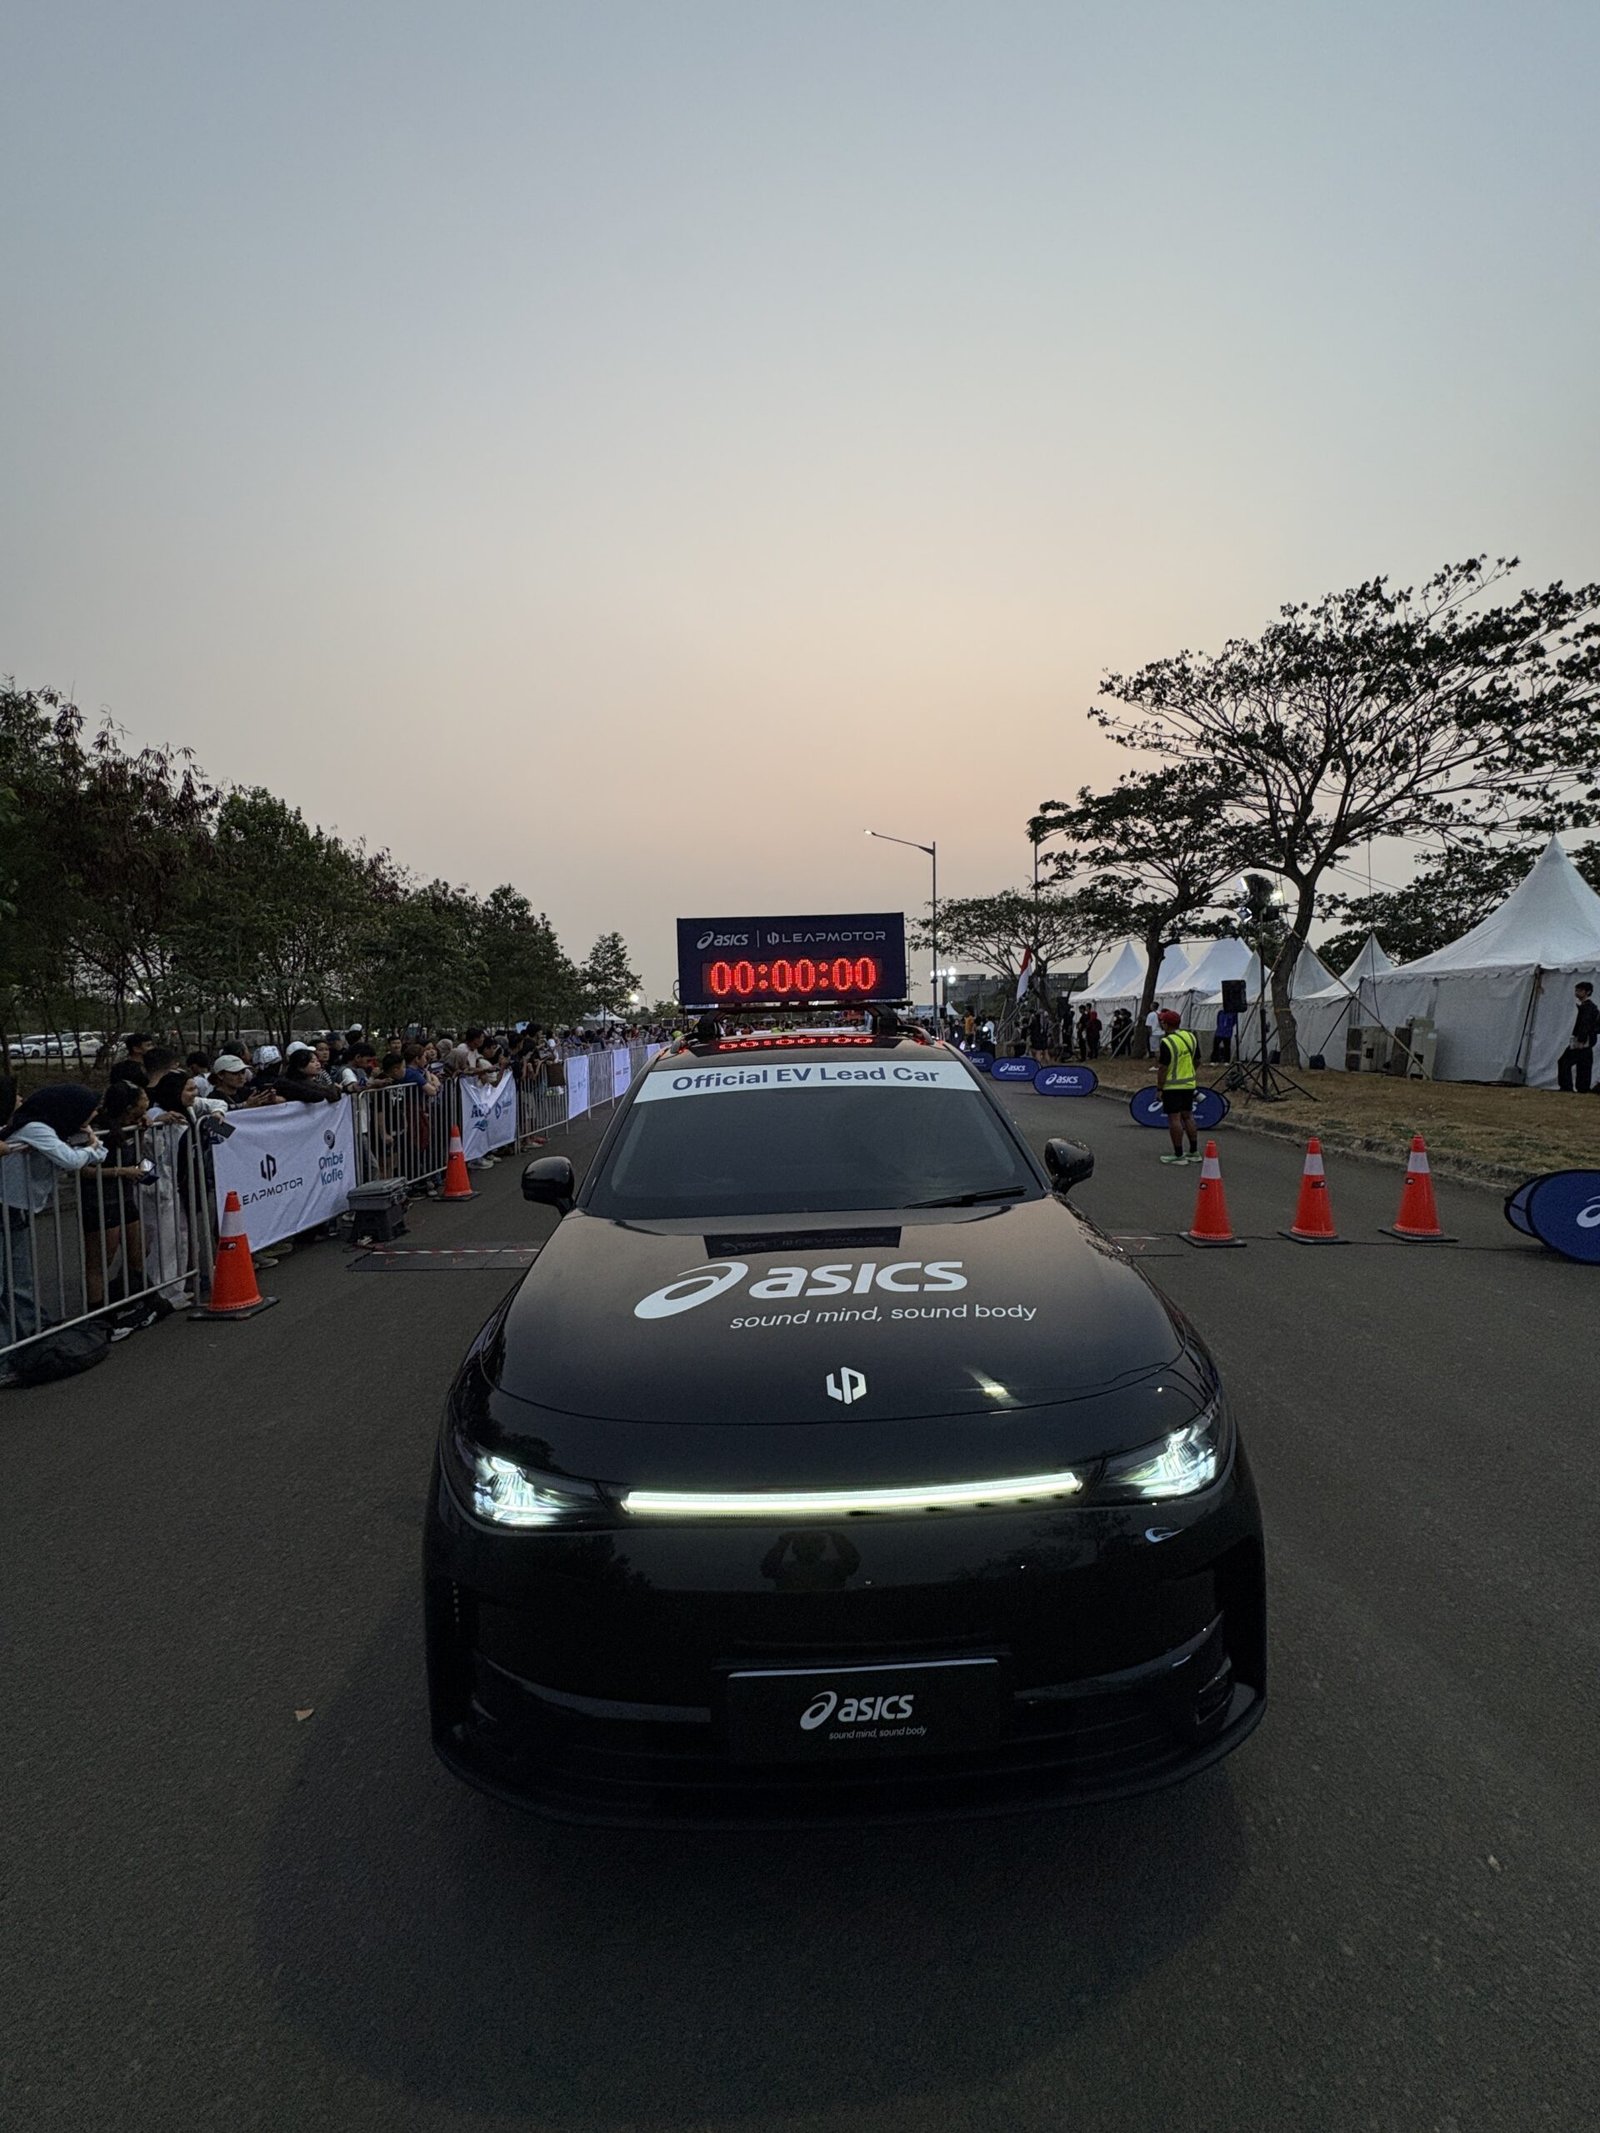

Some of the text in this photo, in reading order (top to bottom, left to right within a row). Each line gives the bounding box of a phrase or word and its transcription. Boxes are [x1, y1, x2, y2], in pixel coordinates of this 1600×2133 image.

[781, 931, 886, 943] LEAPMOTOR
[710, 956, 877, 995] 00:00:00
[672, 1066, 940, 1091] Official EV Lead Car
[320, 1169, 344, 1186] Kofie
[239, 1177, 304, 1206] EAPMOTOR
[729, 1303, 1037, 1330] sound mind, sound body
[828, 1725, 928, 1740] sound mind, sound body
